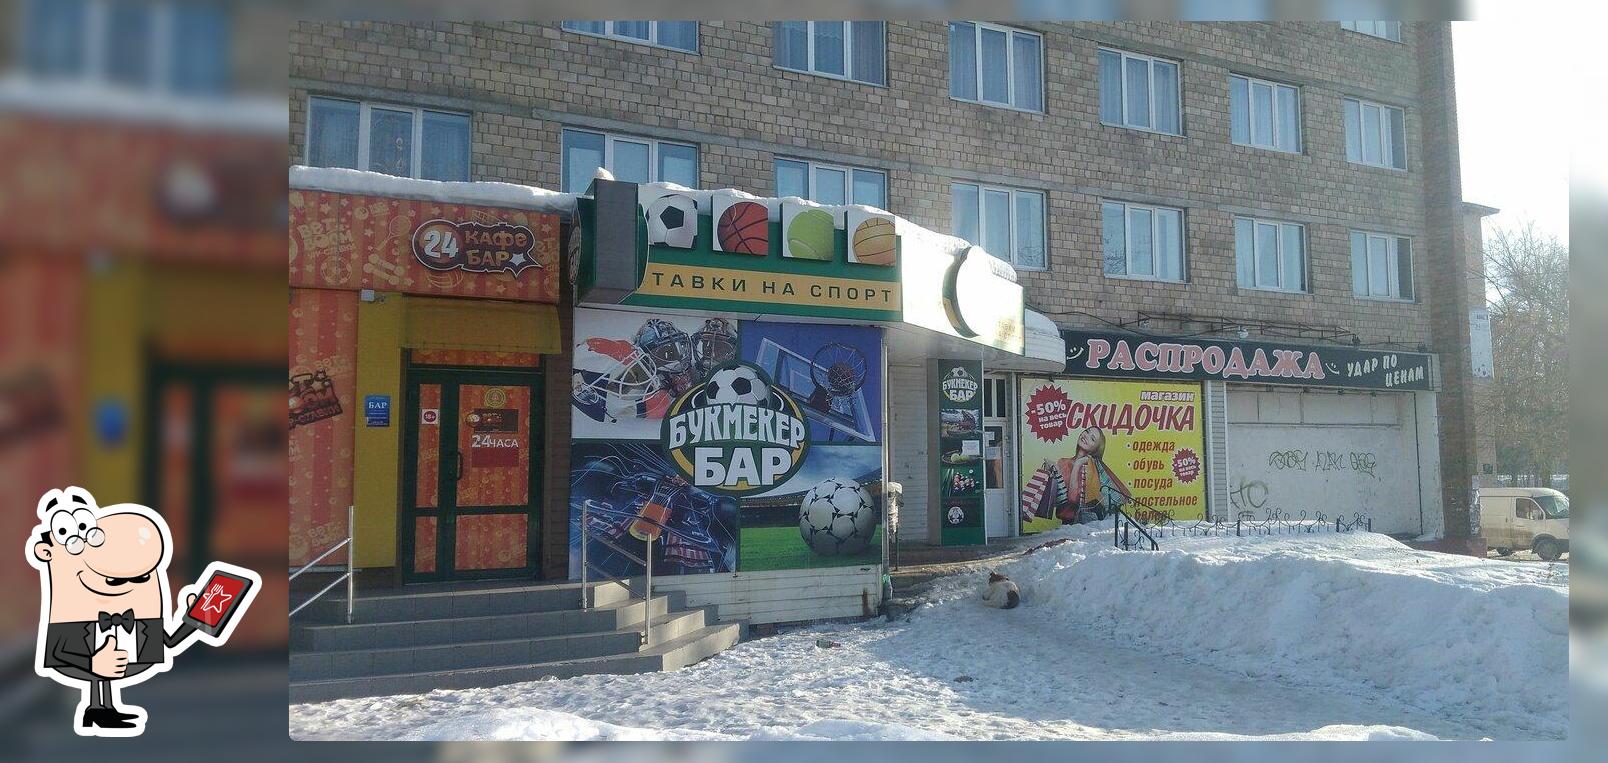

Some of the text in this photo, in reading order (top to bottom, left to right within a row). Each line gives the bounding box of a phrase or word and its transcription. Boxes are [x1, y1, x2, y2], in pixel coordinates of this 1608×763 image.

[424, 229, 458, 258] 24
[466, 249, 510, 266] БАР
[652, 272, 891, 302] ТАВКИ НА СПОРТ
[1085, 338, 1325, 380] РАСПРОДАЖА
[1347, 354, 1398, 377] УДАР ПО
[1385, 365, 1424, 387] ЦЕНАМ
[943, 379, 978, 391] БУКМЕКЕР
[950, 389, 973, 401] БАР
[1140, 390, 1195, 402] магазин
[368, 401, 387, 409] БАР
[1031, 400, 1066, 415] -50%
[1050, 412, 1066, 420] весь
[1066, 401, 1195, 435] СКИДОЧКА
[669, 404, 805, 449] БУКМЕКЕР
[1040, 421, 1063, 429] товар
[1132, 441, 1175, 453] одежда
[695, 447, 791, 486] БАР
[1133, 458, 1165, 472] обувь
[1134, 478, 1173, 491] посуда
[1134, 495, 1198, 507] постельное
